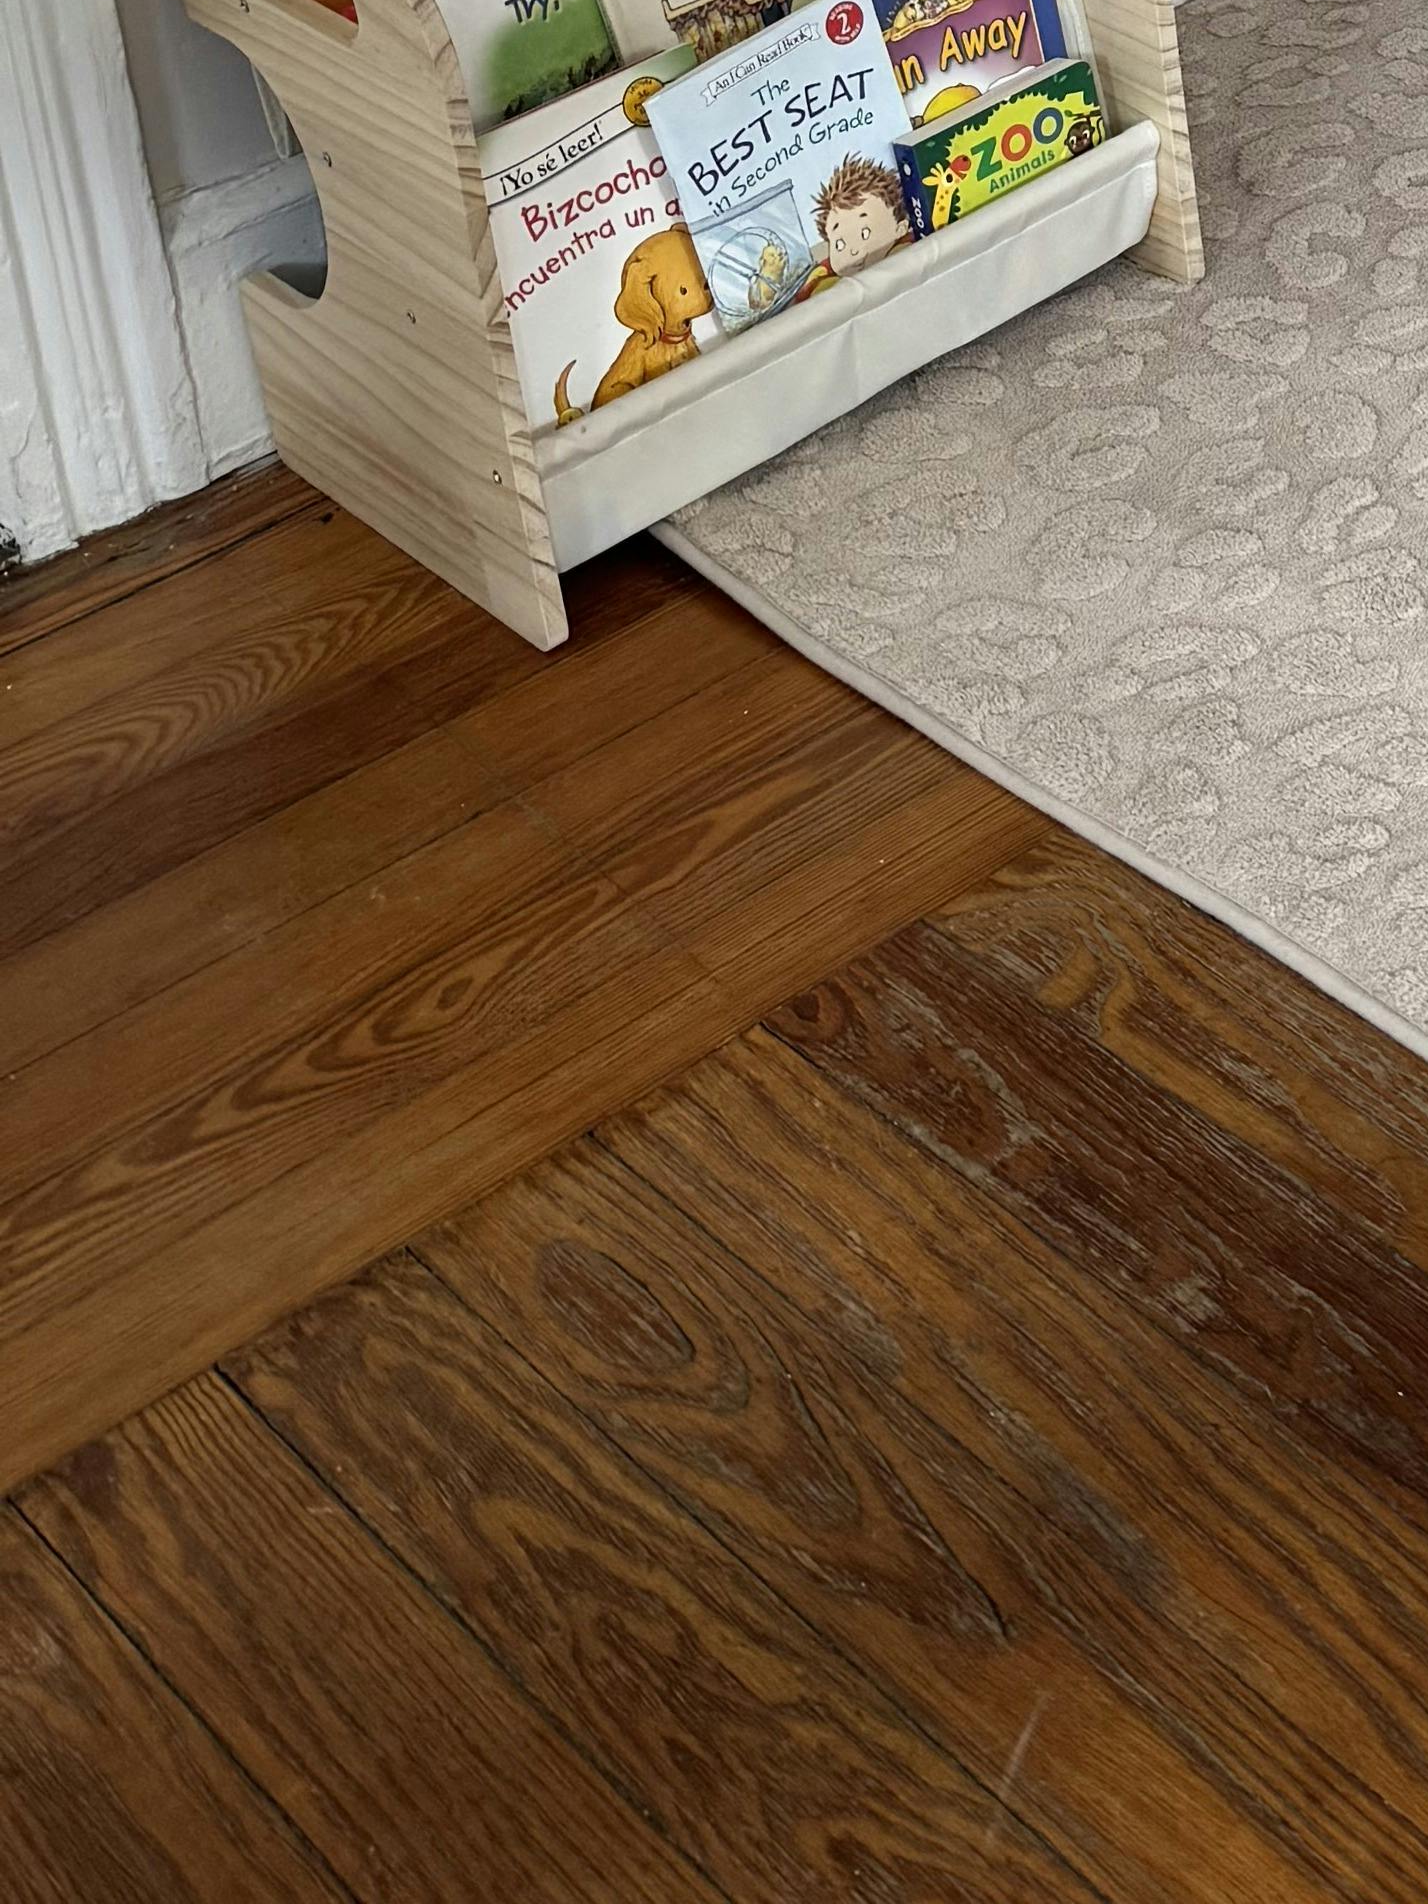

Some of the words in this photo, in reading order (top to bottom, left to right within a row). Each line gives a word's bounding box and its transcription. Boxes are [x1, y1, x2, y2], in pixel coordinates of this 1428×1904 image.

[940, 11, 1026, 72] Away
[750, 76, 790, 107] The
[537, 151, 556, 179] sé
[562, 124, 604, 167] leer!
[688, 117, 772, 196] BEST
[784, 68, 874, 128] SEAT
[709, 193, 731, 217] in
[732, 139, 803, 198] Second
[809, 109, 874, 146] Grade
[971, 107, 1064, 182] ZOO
[520, 155, 667, 242] Bizcocho
[990, 148, 1055, 194] Animals
